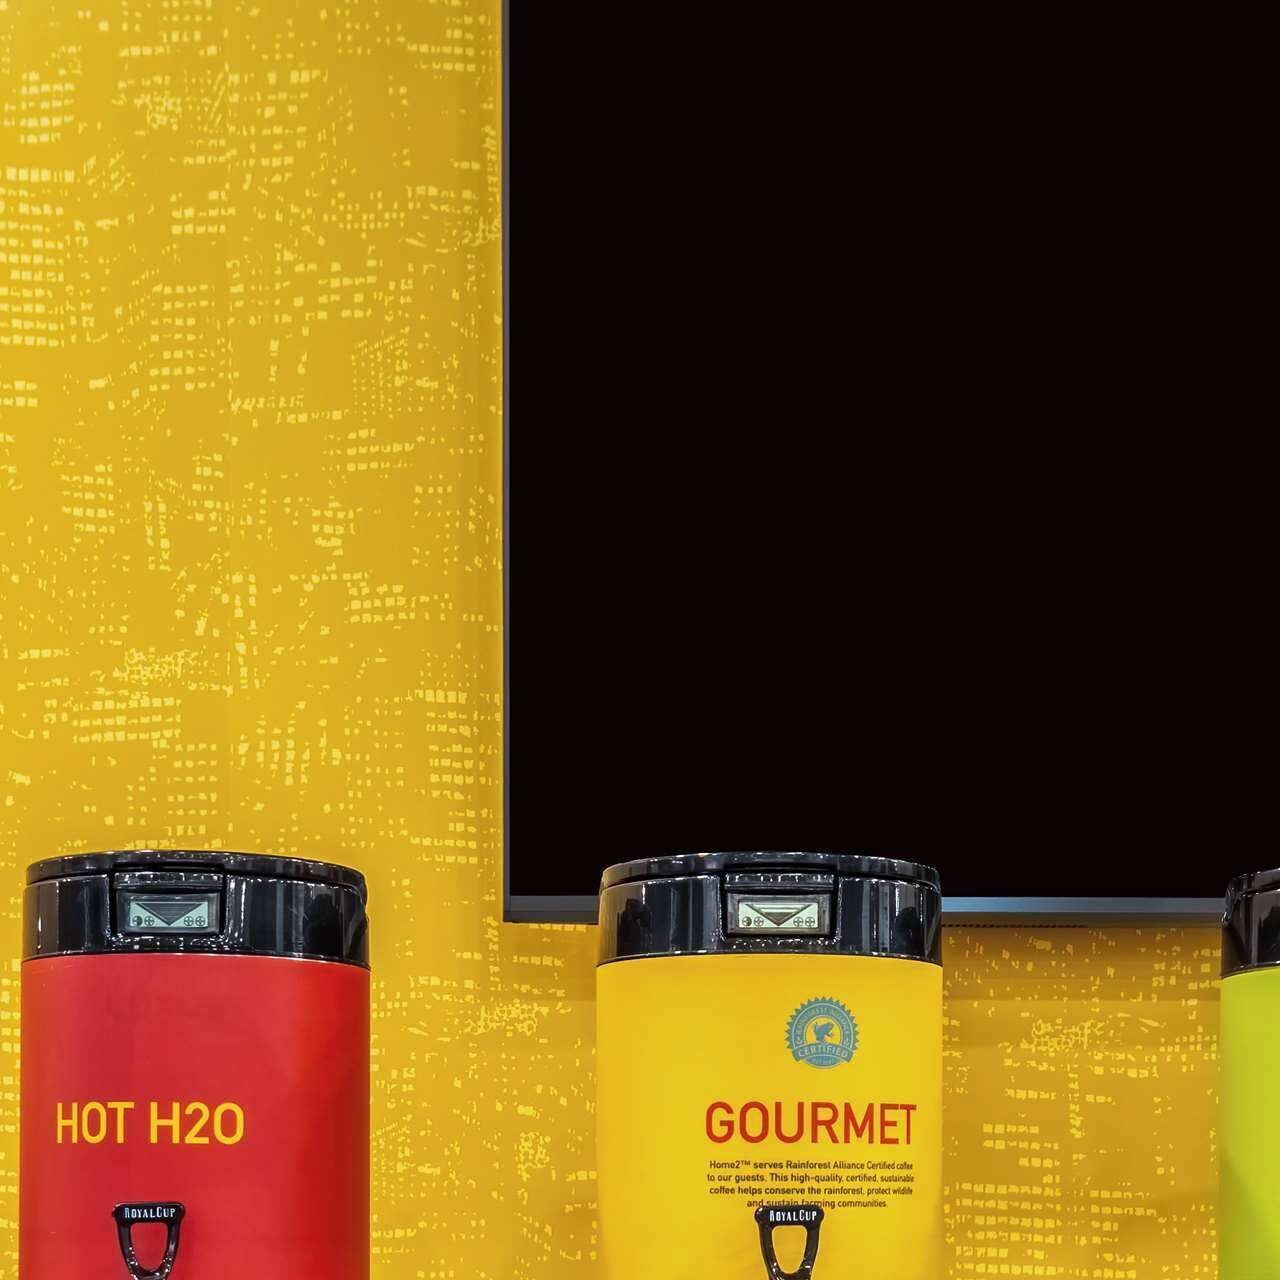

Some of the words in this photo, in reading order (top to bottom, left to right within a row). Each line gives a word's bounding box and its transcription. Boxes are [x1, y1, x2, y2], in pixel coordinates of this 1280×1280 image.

[798, 1045, 848, 1057] CERTIFIED
[56, 1101, 135, 1144] HOT
[705, 1101, 917, 1145] GOURMET
[786, 1160, 831, 1169] Rainforest
[833, 1161, 865, 1170] Alliance
[867, 1161, 896, 1170] Certified
[707, 1174, 716, 1182] to
[735, 1174, 767, 1183] guests.
[770, 1173, 788, 1182] This
[710, 1186, 736, 1194] coffee
[738, 1186, 762, 1196] helps
[765, 1187, 805, 1195] conserve
[808, 1186, 821, 1195] the
[867, 1187, 890, 1197] protect
[747, 1199, 763, 1207] and
